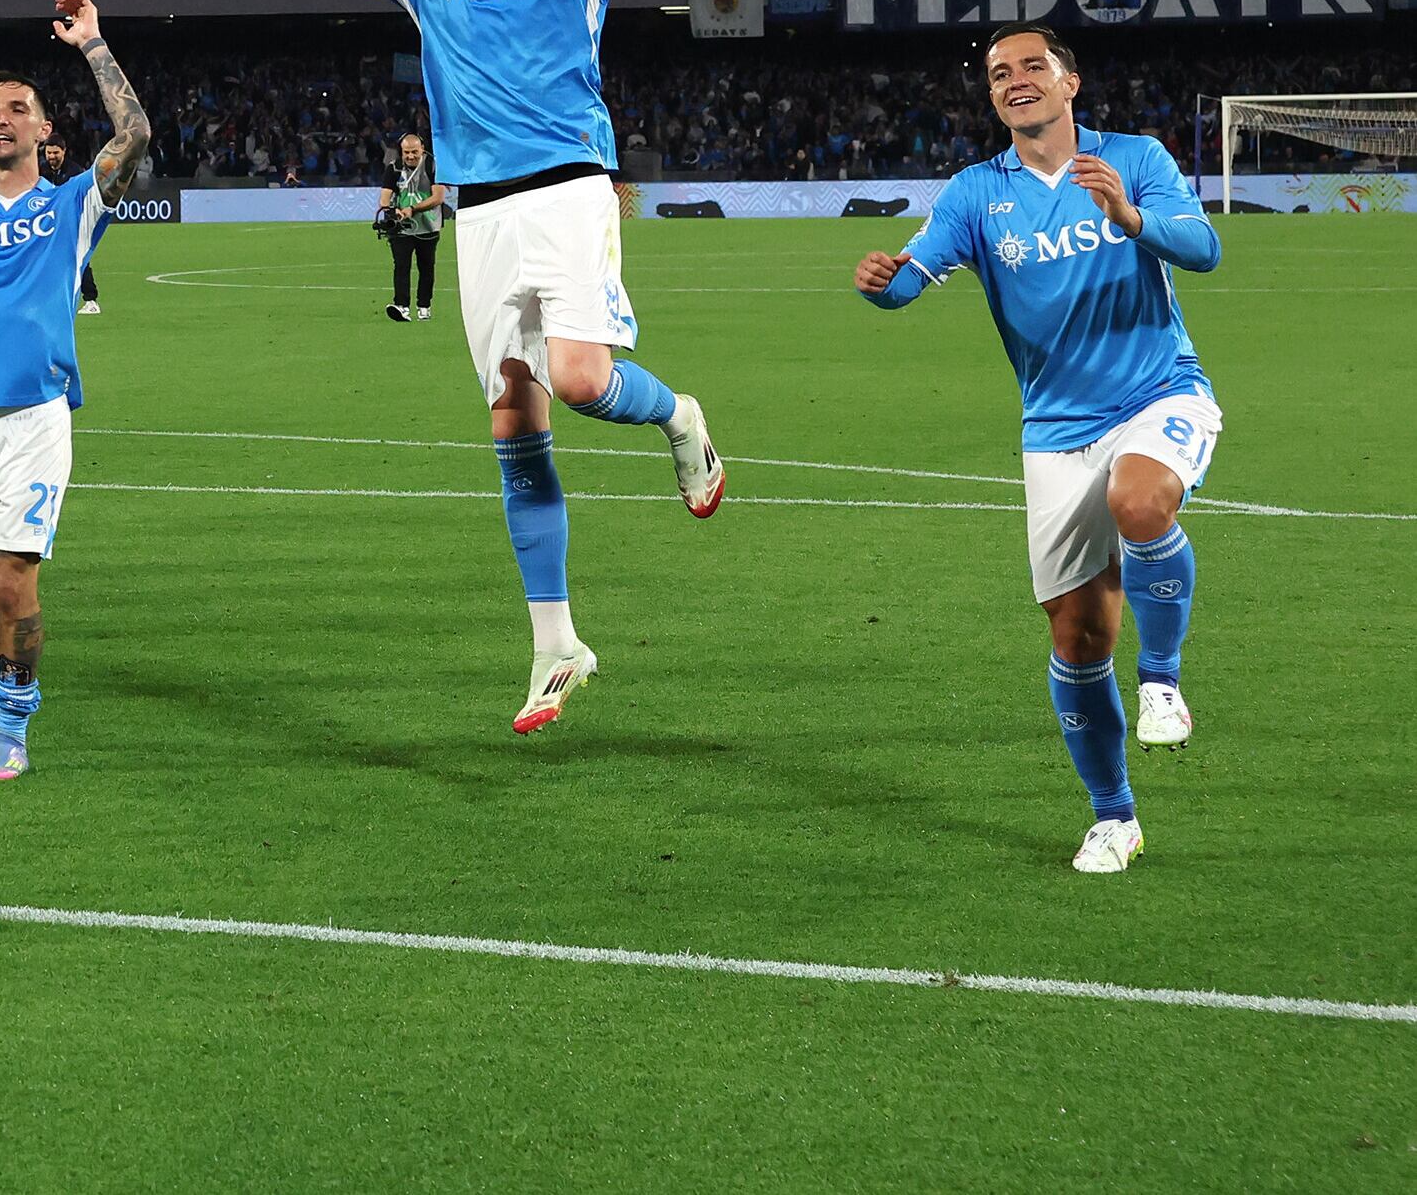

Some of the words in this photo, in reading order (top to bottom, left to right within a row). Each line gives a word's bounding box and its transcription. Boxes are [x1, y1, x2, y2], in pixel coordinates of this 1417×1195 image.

[1096, 9, 1127, 23] 1979
[116, 199, 171, 221] 00:00
[988, 202, 1015, 216] EA7
[1032, 218, 1128, 263] MSC
[1162, 416, 1207, 466] 81
[23, 482, 58, 526] 21
